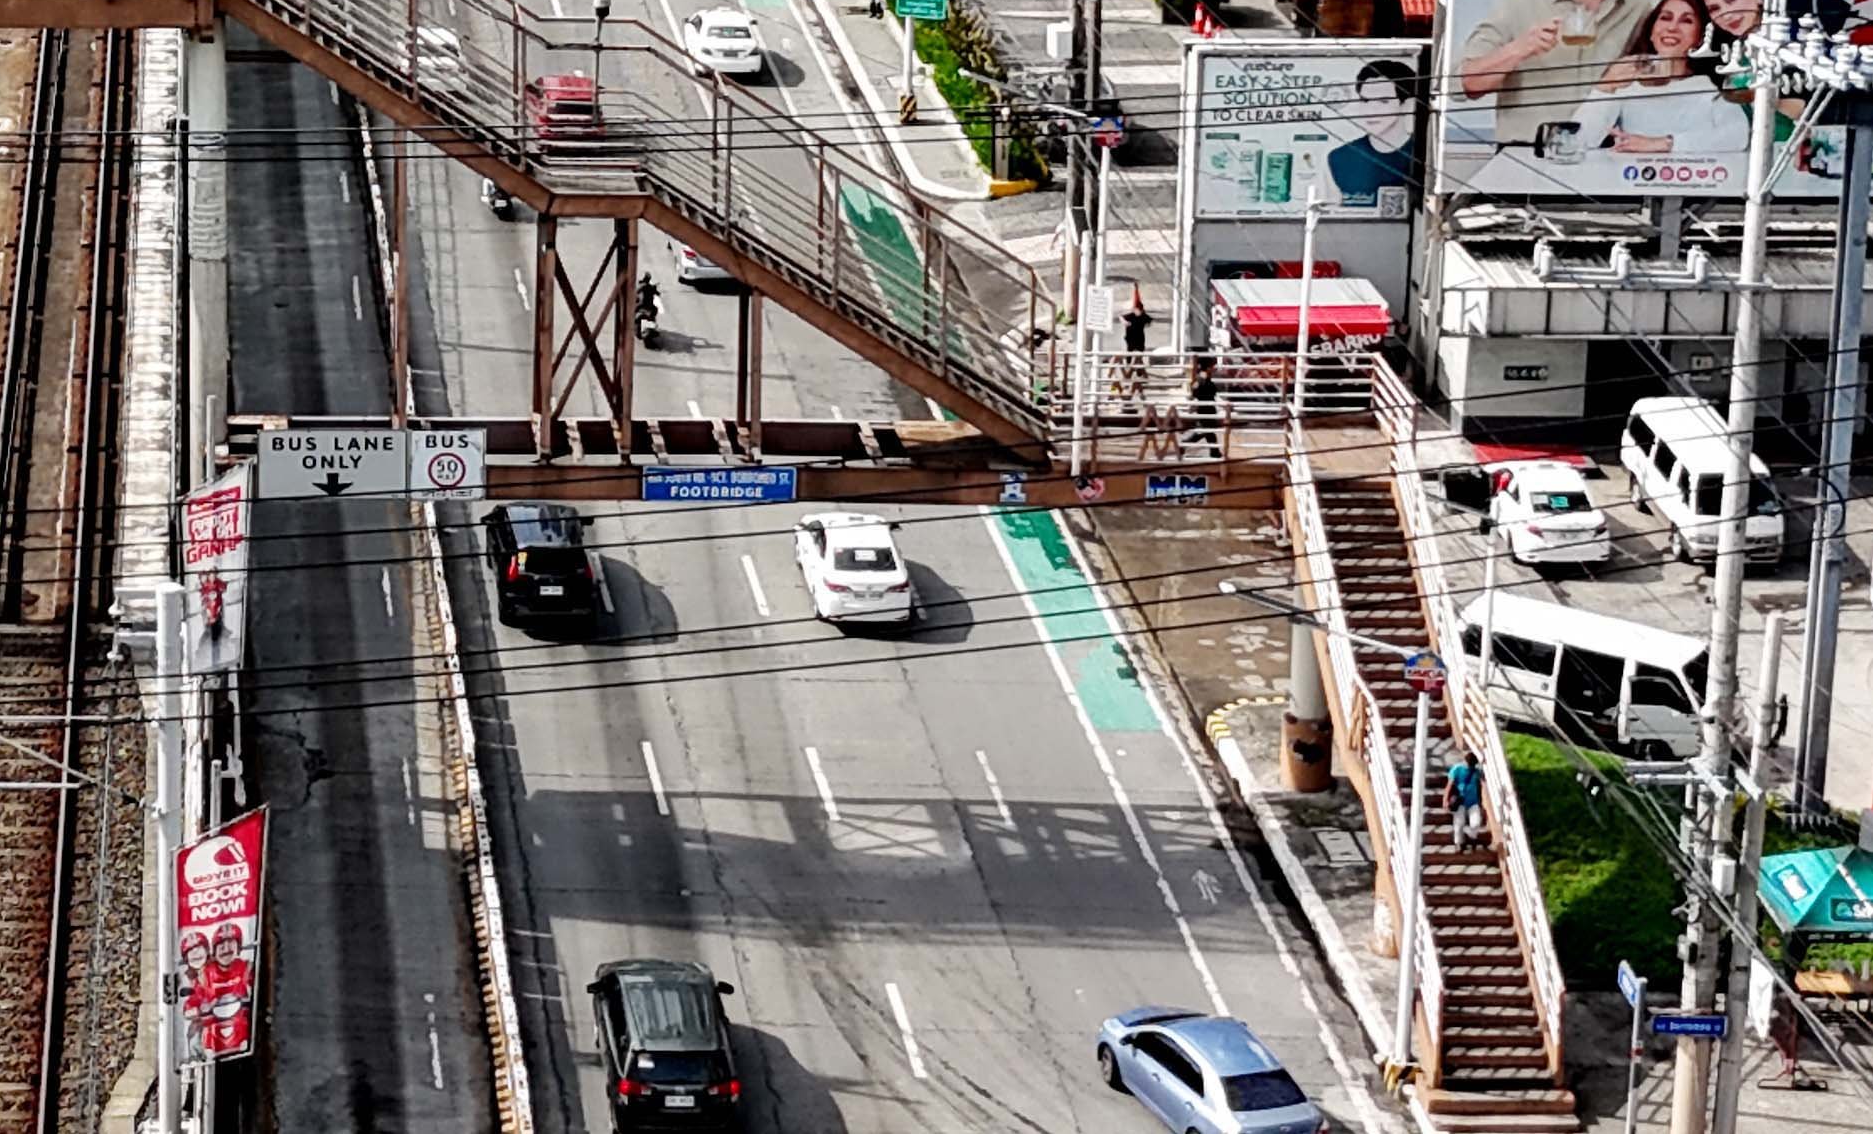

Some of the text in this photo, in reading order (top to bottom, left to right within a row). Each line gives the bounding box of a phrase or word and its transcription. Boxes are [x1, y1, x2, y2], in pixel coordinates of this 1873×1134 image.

[1215, 75, 1259, 88] EASY
[1224, 92, 1313, 106] SOLUTION
[1213, 109, 1323, 122] TO CLEAR SKIN
[272, 437, 394, 451] BUS LANE
[425, 435, 469, 448] BUS
[302, 455, 362, 470] ONLY
[670, 486, 763, 498] FOOTBRIDGE
[188, 881, 248, 907] BOOK
[191, 896, 246, 922] NOW!
